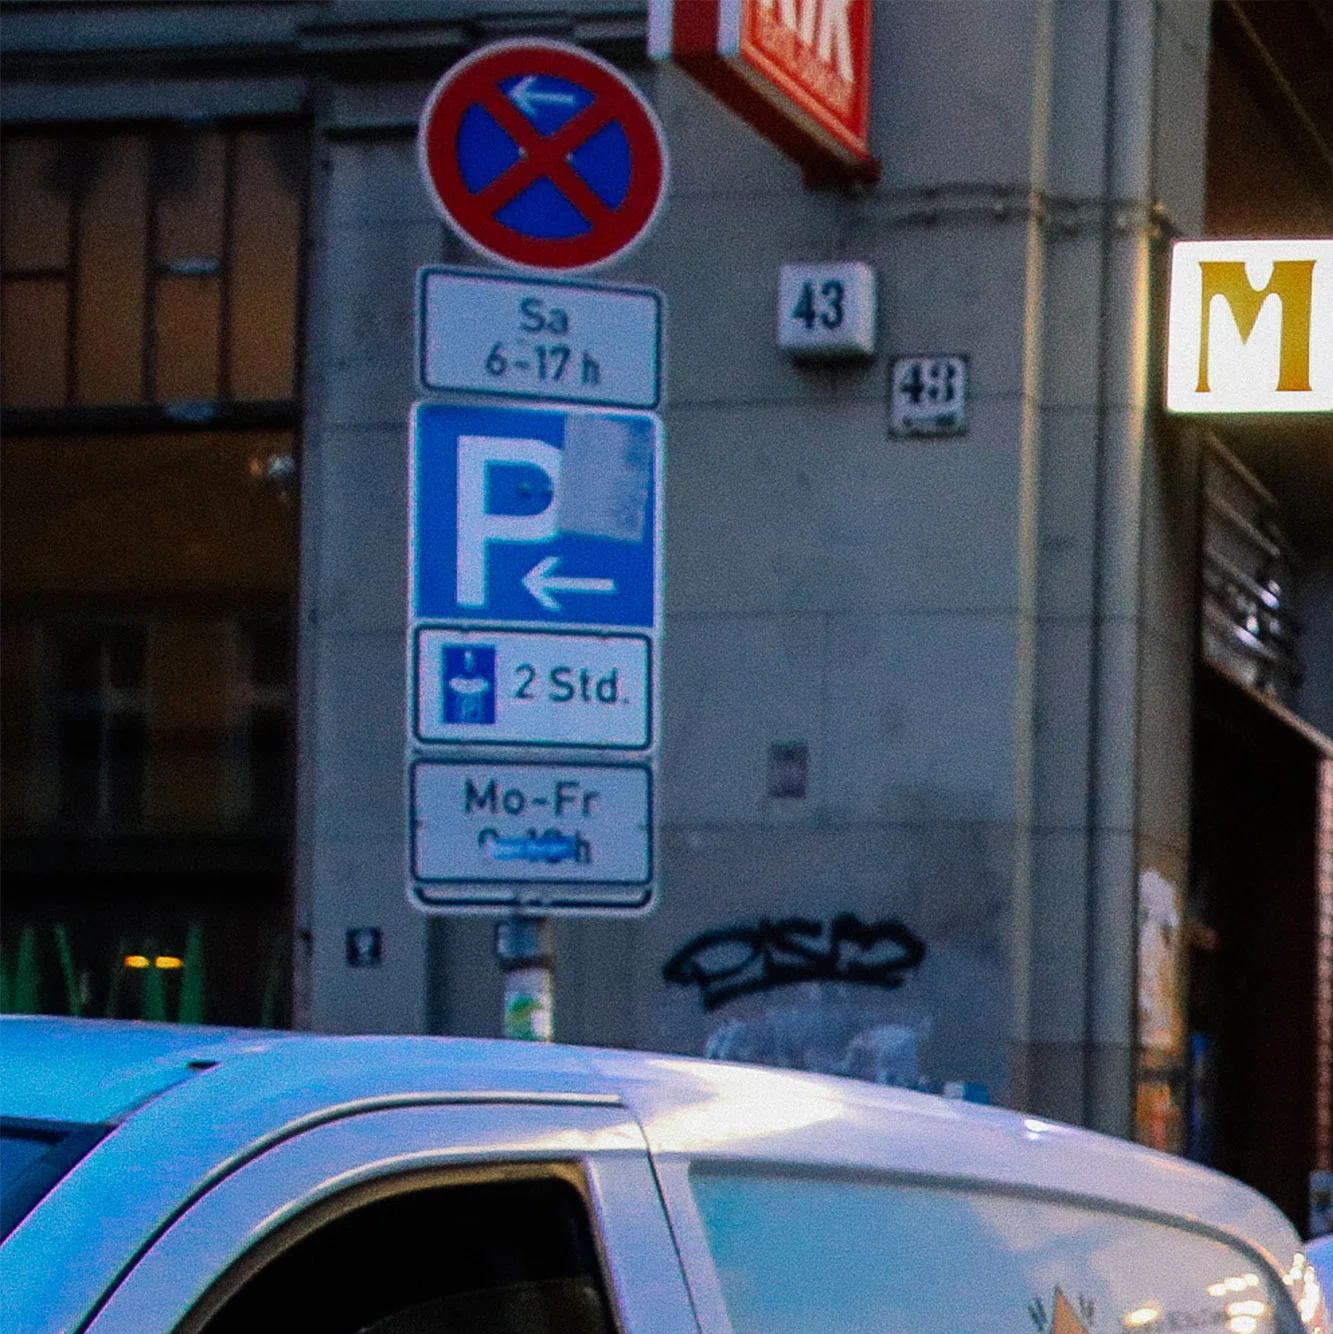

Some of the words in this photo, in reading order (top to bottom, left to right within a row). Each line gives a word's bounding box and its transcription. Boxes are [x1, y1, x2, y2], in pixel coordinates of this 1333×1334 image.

[518, 296, 570, 334] Sa
[792, 279, 844, 329] 43
[456, 434, 562, 609] P
[514, 662, 536, 700] 2
[549, 665, 630, 704] Std.
[464, 778, 601, 817] Mo-Fr
